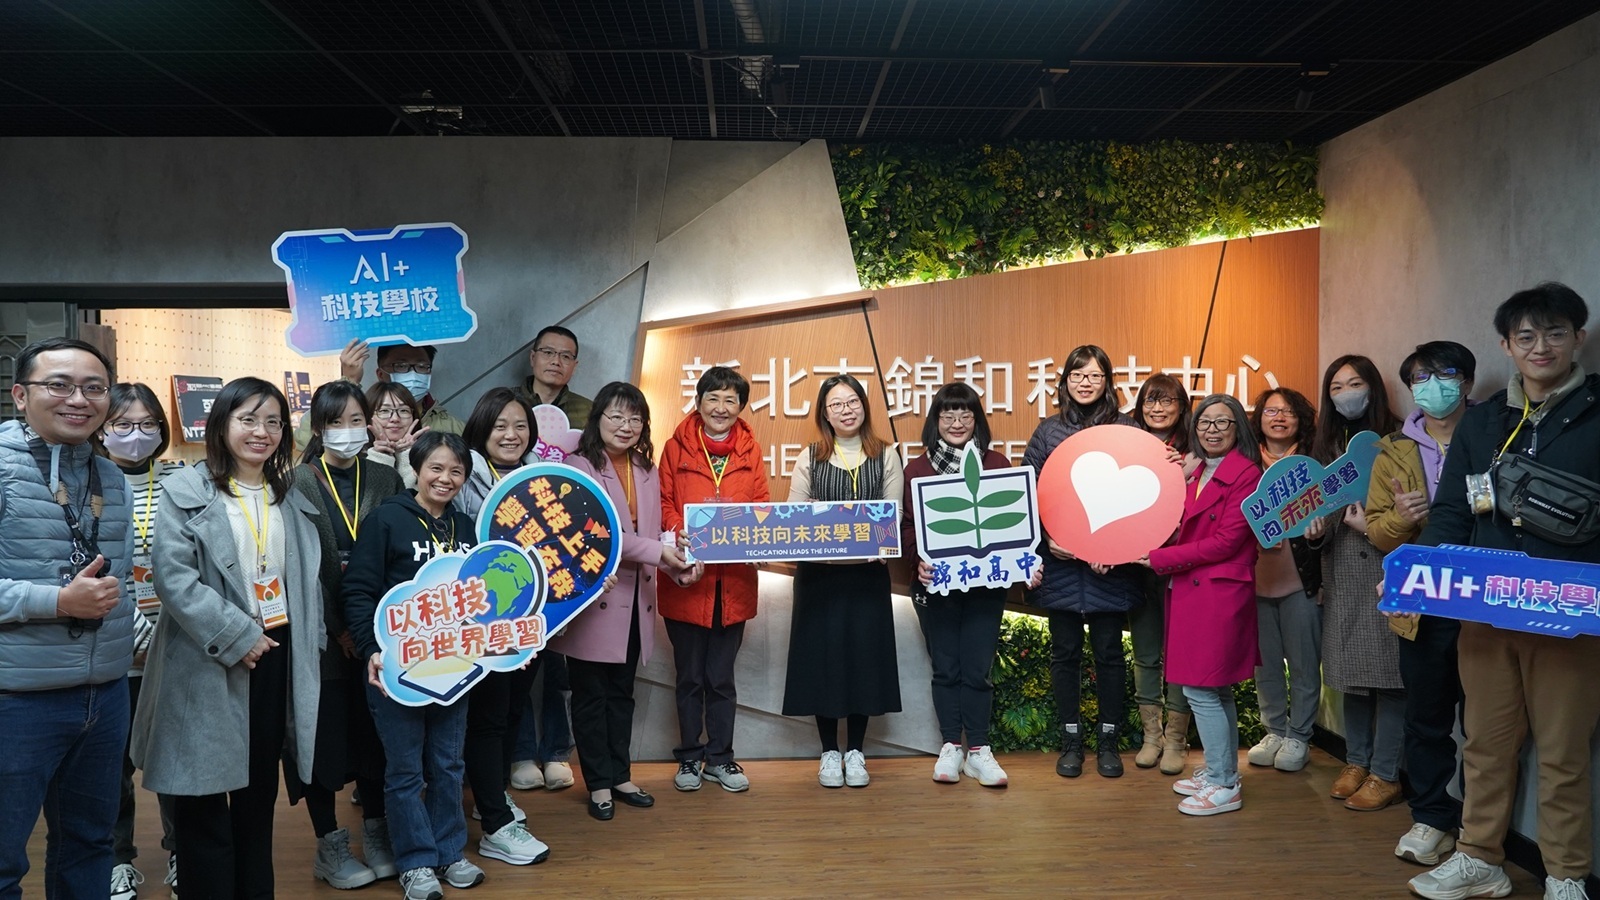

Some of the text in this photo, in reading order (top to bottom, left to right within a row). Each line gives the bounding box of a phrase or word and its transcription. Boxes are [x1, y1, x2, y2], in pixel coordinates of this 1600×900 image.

[350, 252, 410, 286] AI+
[320, 286, 440, 322] 科技學校
[1248, 460, 1313, 521] 以科技
[1261, 460, 1360, 543] 向未來學習
[494, 494, 576, 600] 學習在我
[527, 476, 607, 575] 科技上手
[710, 522, 872, 546] 以科技向未來學習
[745, 549, 788, 557] TECHCATION
[929, 551, 1037, 590] 錦和高中
[388, 578, 490, 634] 以科技
[1400, 563, 1600, 618] AI+ 科技學
[401, 618, 540, 665] 向世界學習
